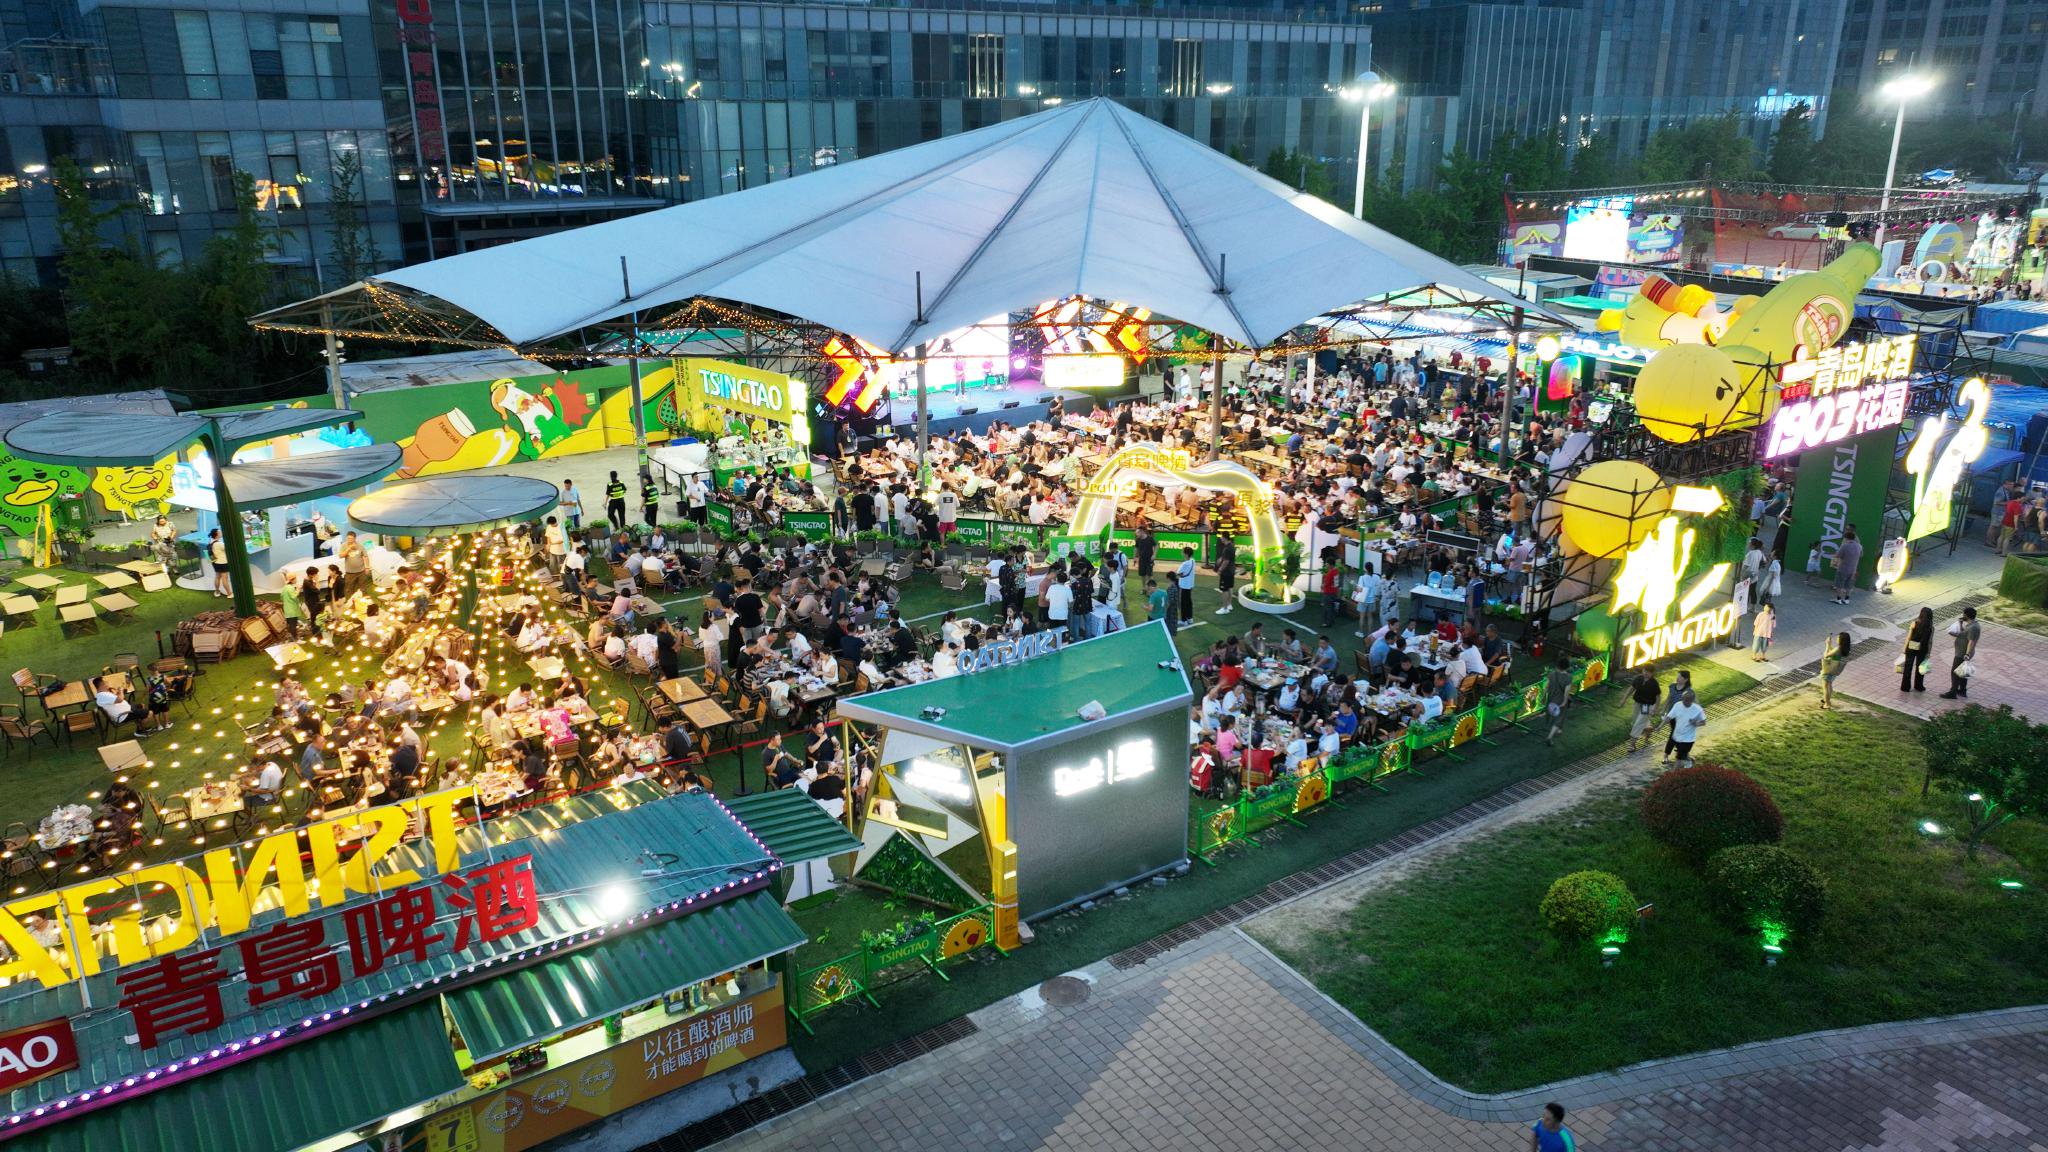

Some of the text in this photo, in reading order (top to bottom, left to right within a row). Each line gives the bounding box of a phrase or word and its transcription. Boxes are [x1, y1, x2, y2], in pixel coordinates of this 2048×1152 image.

[699, 369, 783, 411] TSINGTAO
[1813, 334, 1916, 397] 青岛啤酒
[1766, 381, 1909, 459] 1903花园
[709, 509, 729, 524] TSINGTAO
[789, 521, 827, 529] TSINGTAO
[1820, 443, 1858, 560] TSINGTAO
[1159, 540, 1199, 550] TSINGTAO
[1623, 603, 1734, 669] TSINGTAO
[117, 854, 540, 1051] 青島啤酒
[881, 939, 930, 965] TSINGTAO
[643, 1003, 754, 1062] 以往酿酒师
[646, 1026, 754, 1079] 才能喝到的啤酒
[440, 1118, 461, 1149] 7
